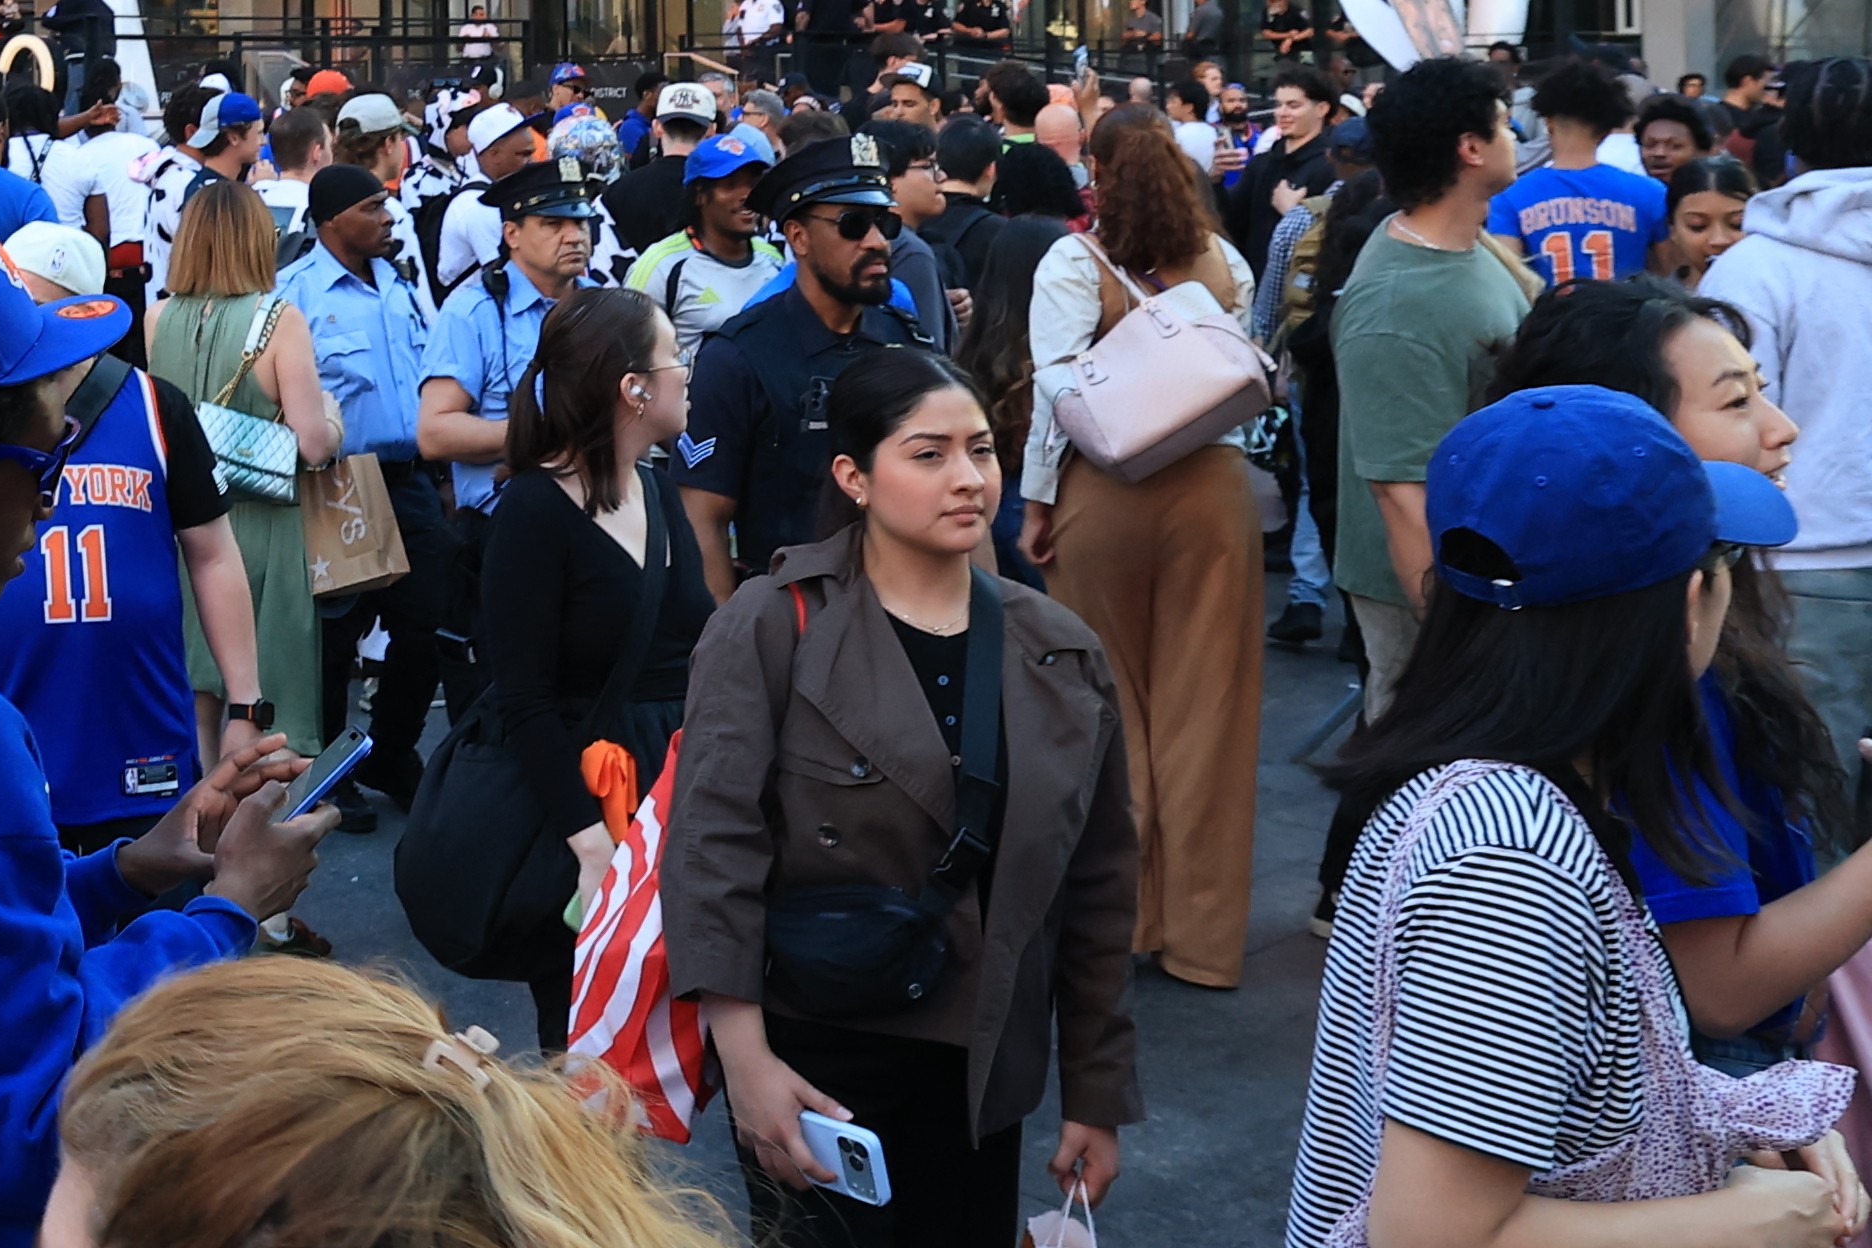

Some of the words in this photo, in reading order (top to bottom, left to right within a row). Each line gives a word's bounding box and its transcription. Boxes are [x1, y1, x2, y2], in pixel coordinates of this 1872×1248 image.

[1518, 196, 1637, 235] BRUNSON
[64, 463, 153, 514] YORK
[40, 523, 113, 624] 11
